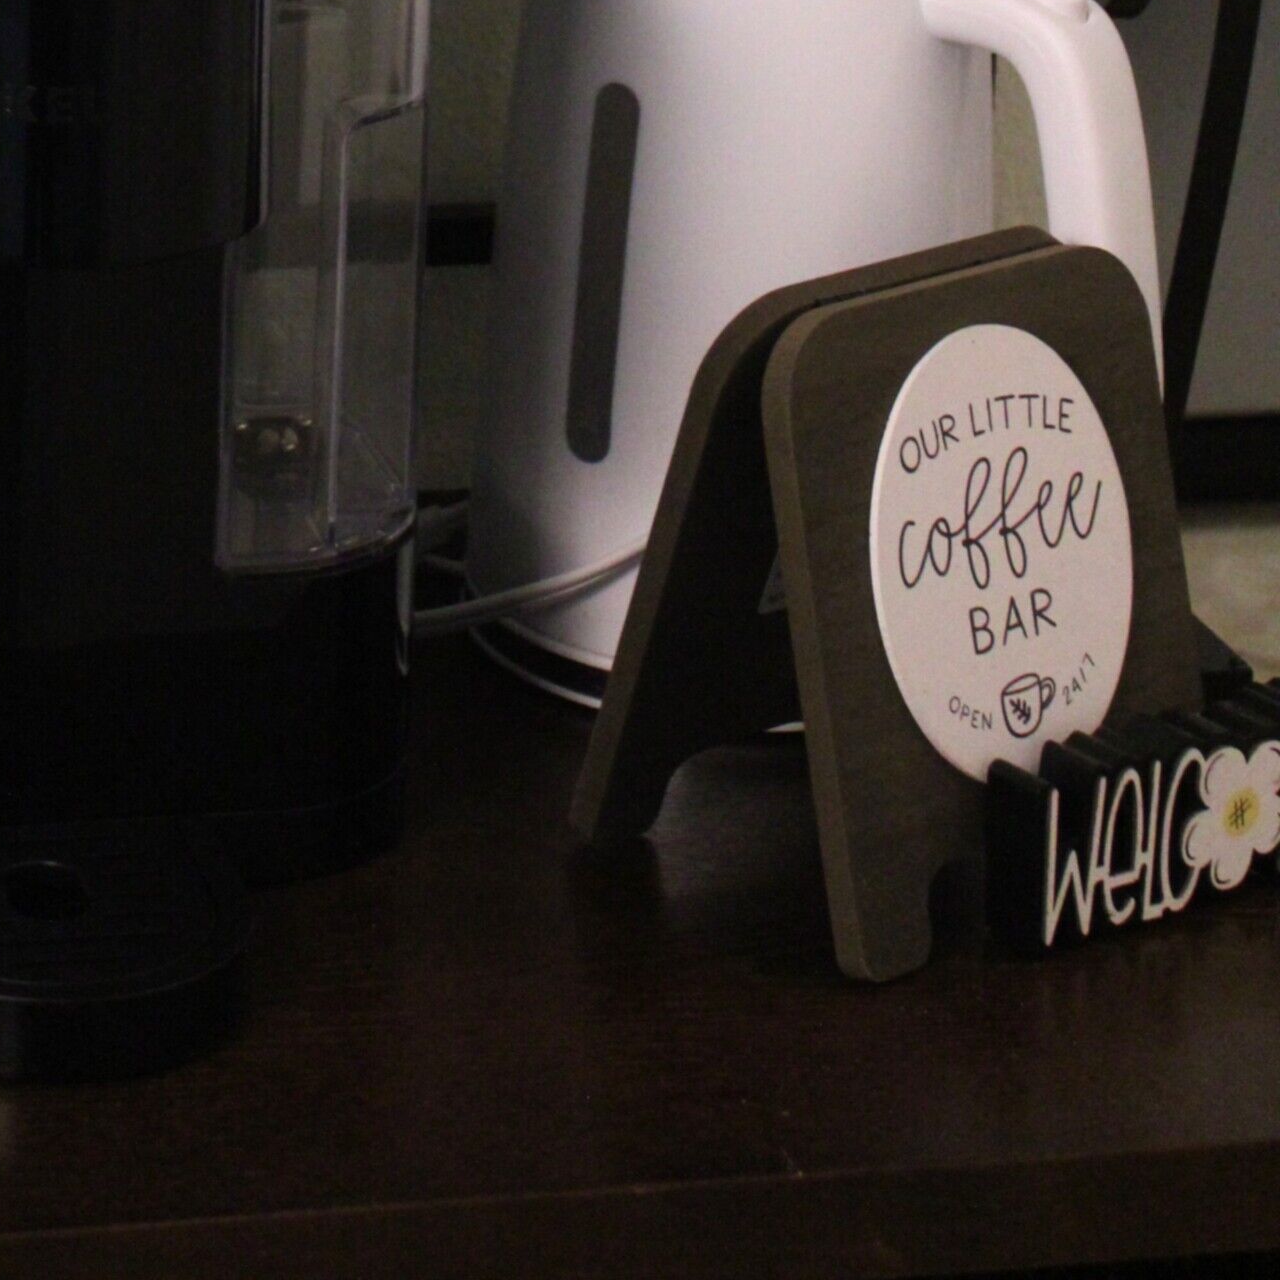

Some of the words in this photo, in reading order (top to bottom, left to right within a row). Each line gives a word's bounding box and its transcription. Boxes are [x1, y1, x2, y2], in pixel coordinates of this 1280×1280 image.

[899, 413, 961, 474] OUR
[968, 393, 1075, 438] LITTLE
[898, 446, 1103, 591] coffee
[968, 587, 1058, 656] BAR
[948, 695, 994, 731] OPEN
[1061, 651, 1097, 706] 24/7
